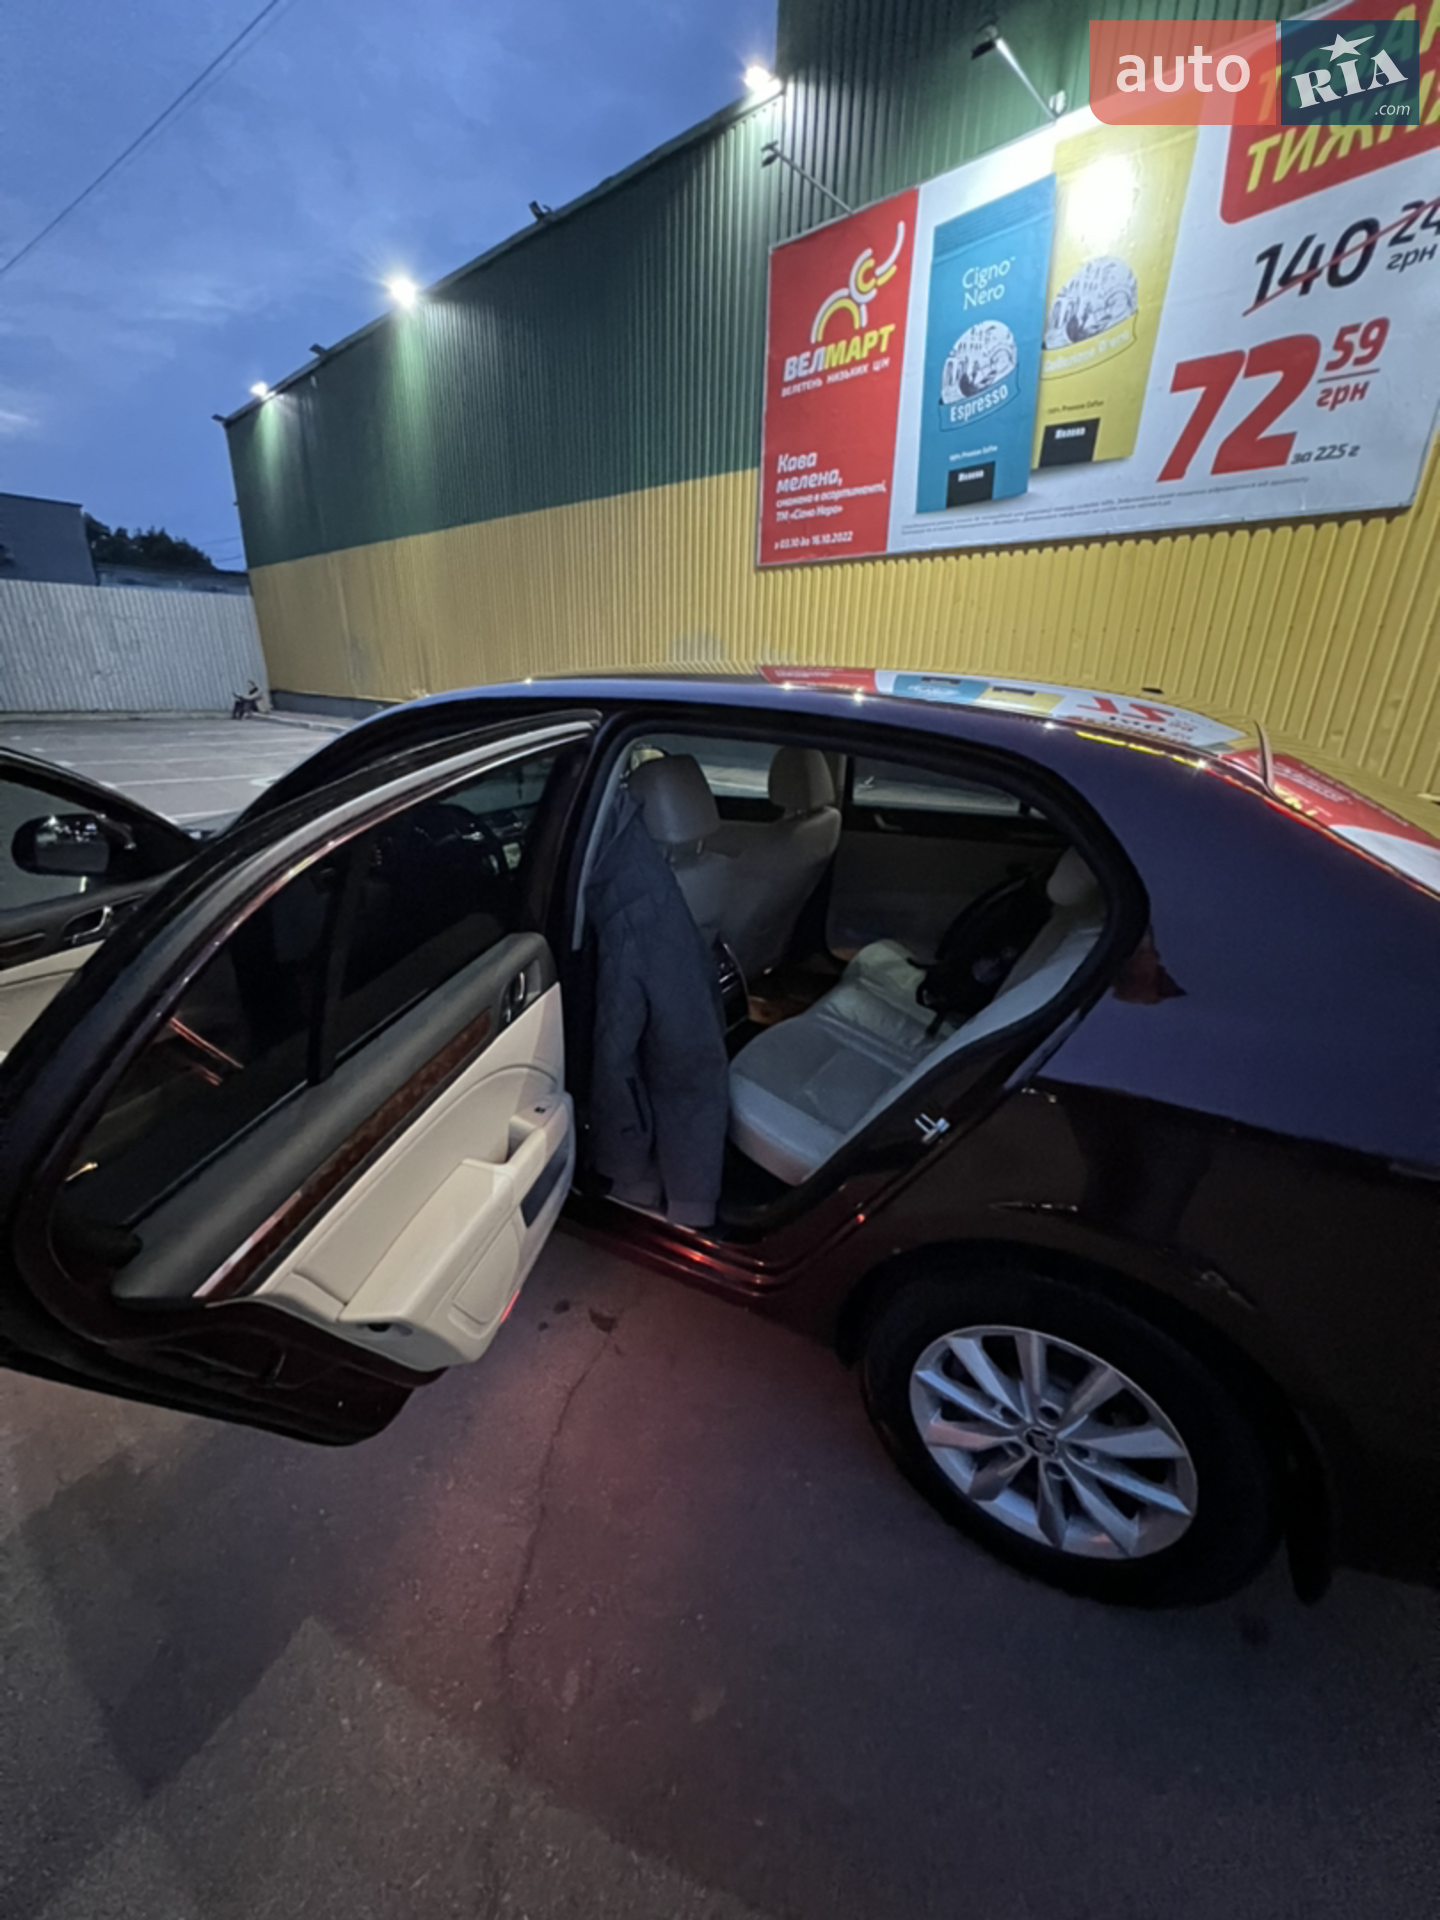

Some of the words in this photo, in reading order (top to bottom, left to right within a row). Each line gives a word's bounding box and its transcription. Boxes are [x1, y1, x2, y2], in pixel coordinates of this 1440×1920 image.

[1253, 217, 1380, 309] 140
[1386, 243, 1438, 273] грн
[962, 259, 1011, 289] Cigno
[963, 284, 1005, 311] Nero
[783, 323, 895, 382] ВЕЛМАРТ
[1325, 317, 1390, 372] 59
[950, 384, 1009, 422] Espresso
[1156, 334, 1321, 483] 72
[1316, 381, 1370, 411] грн
[777, 452, 817, 473] Кава
[1314, 443, 1348, 462] 225
